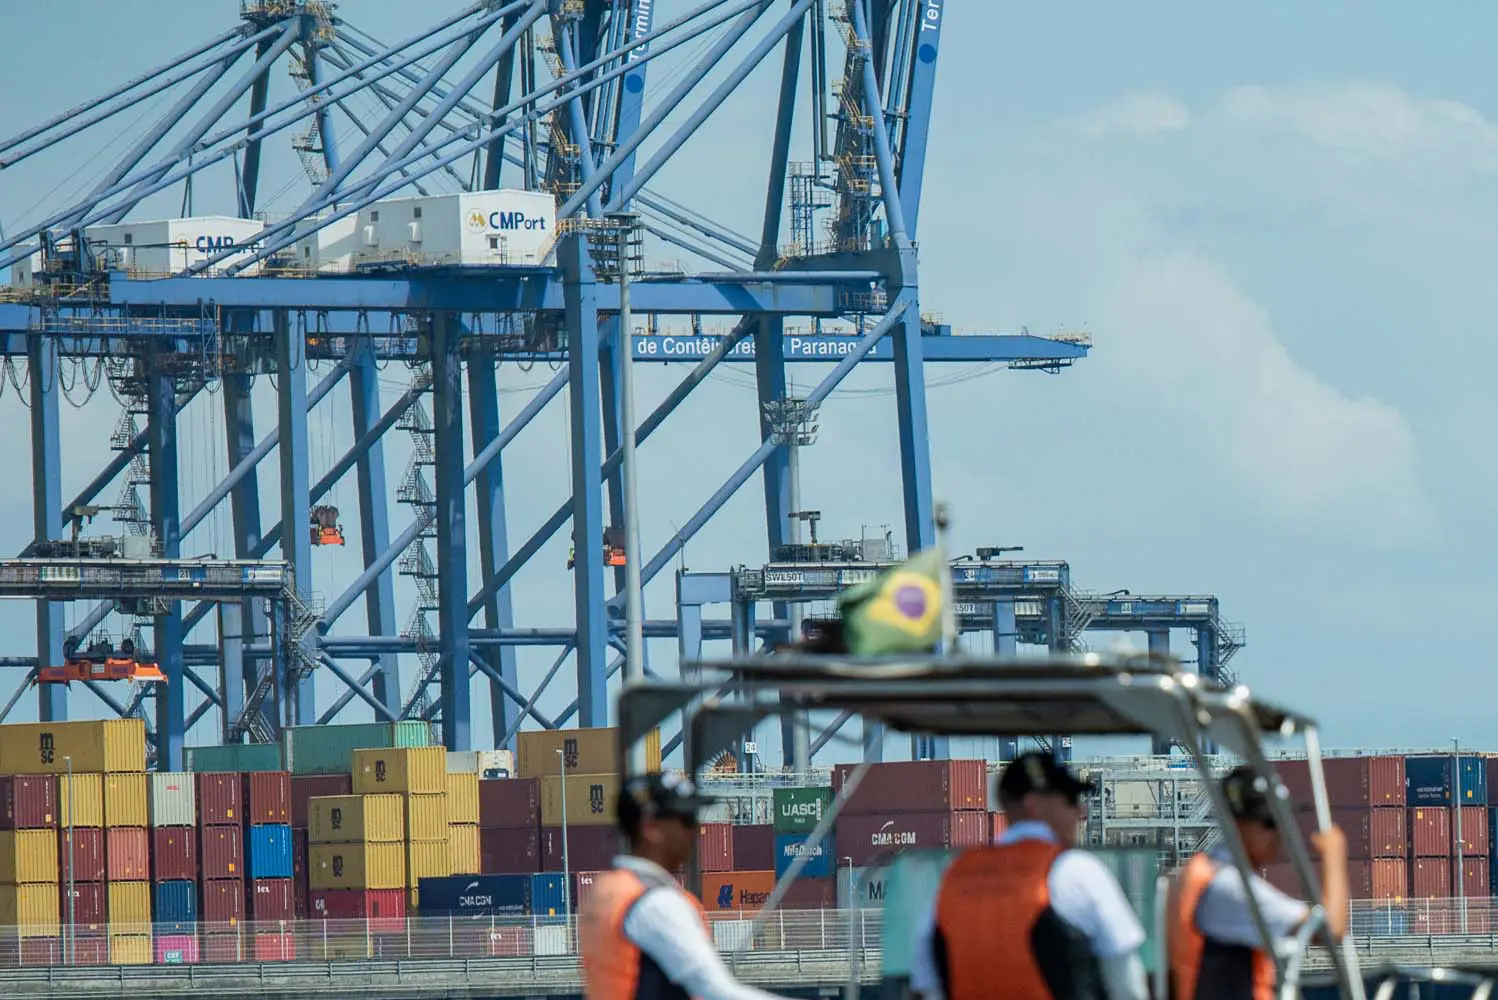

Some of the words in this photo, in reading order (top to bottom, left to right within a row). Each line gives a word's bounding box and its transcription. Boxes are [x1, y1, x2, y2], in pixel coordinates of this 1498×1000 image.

[489, 211, 546, 230] CMPort
[638, 337, 657, 354] de
[782, 803, 816, 817] UASC
[872, 833, 892, 845] CMA
[894, 832, 916, 844] CGM
